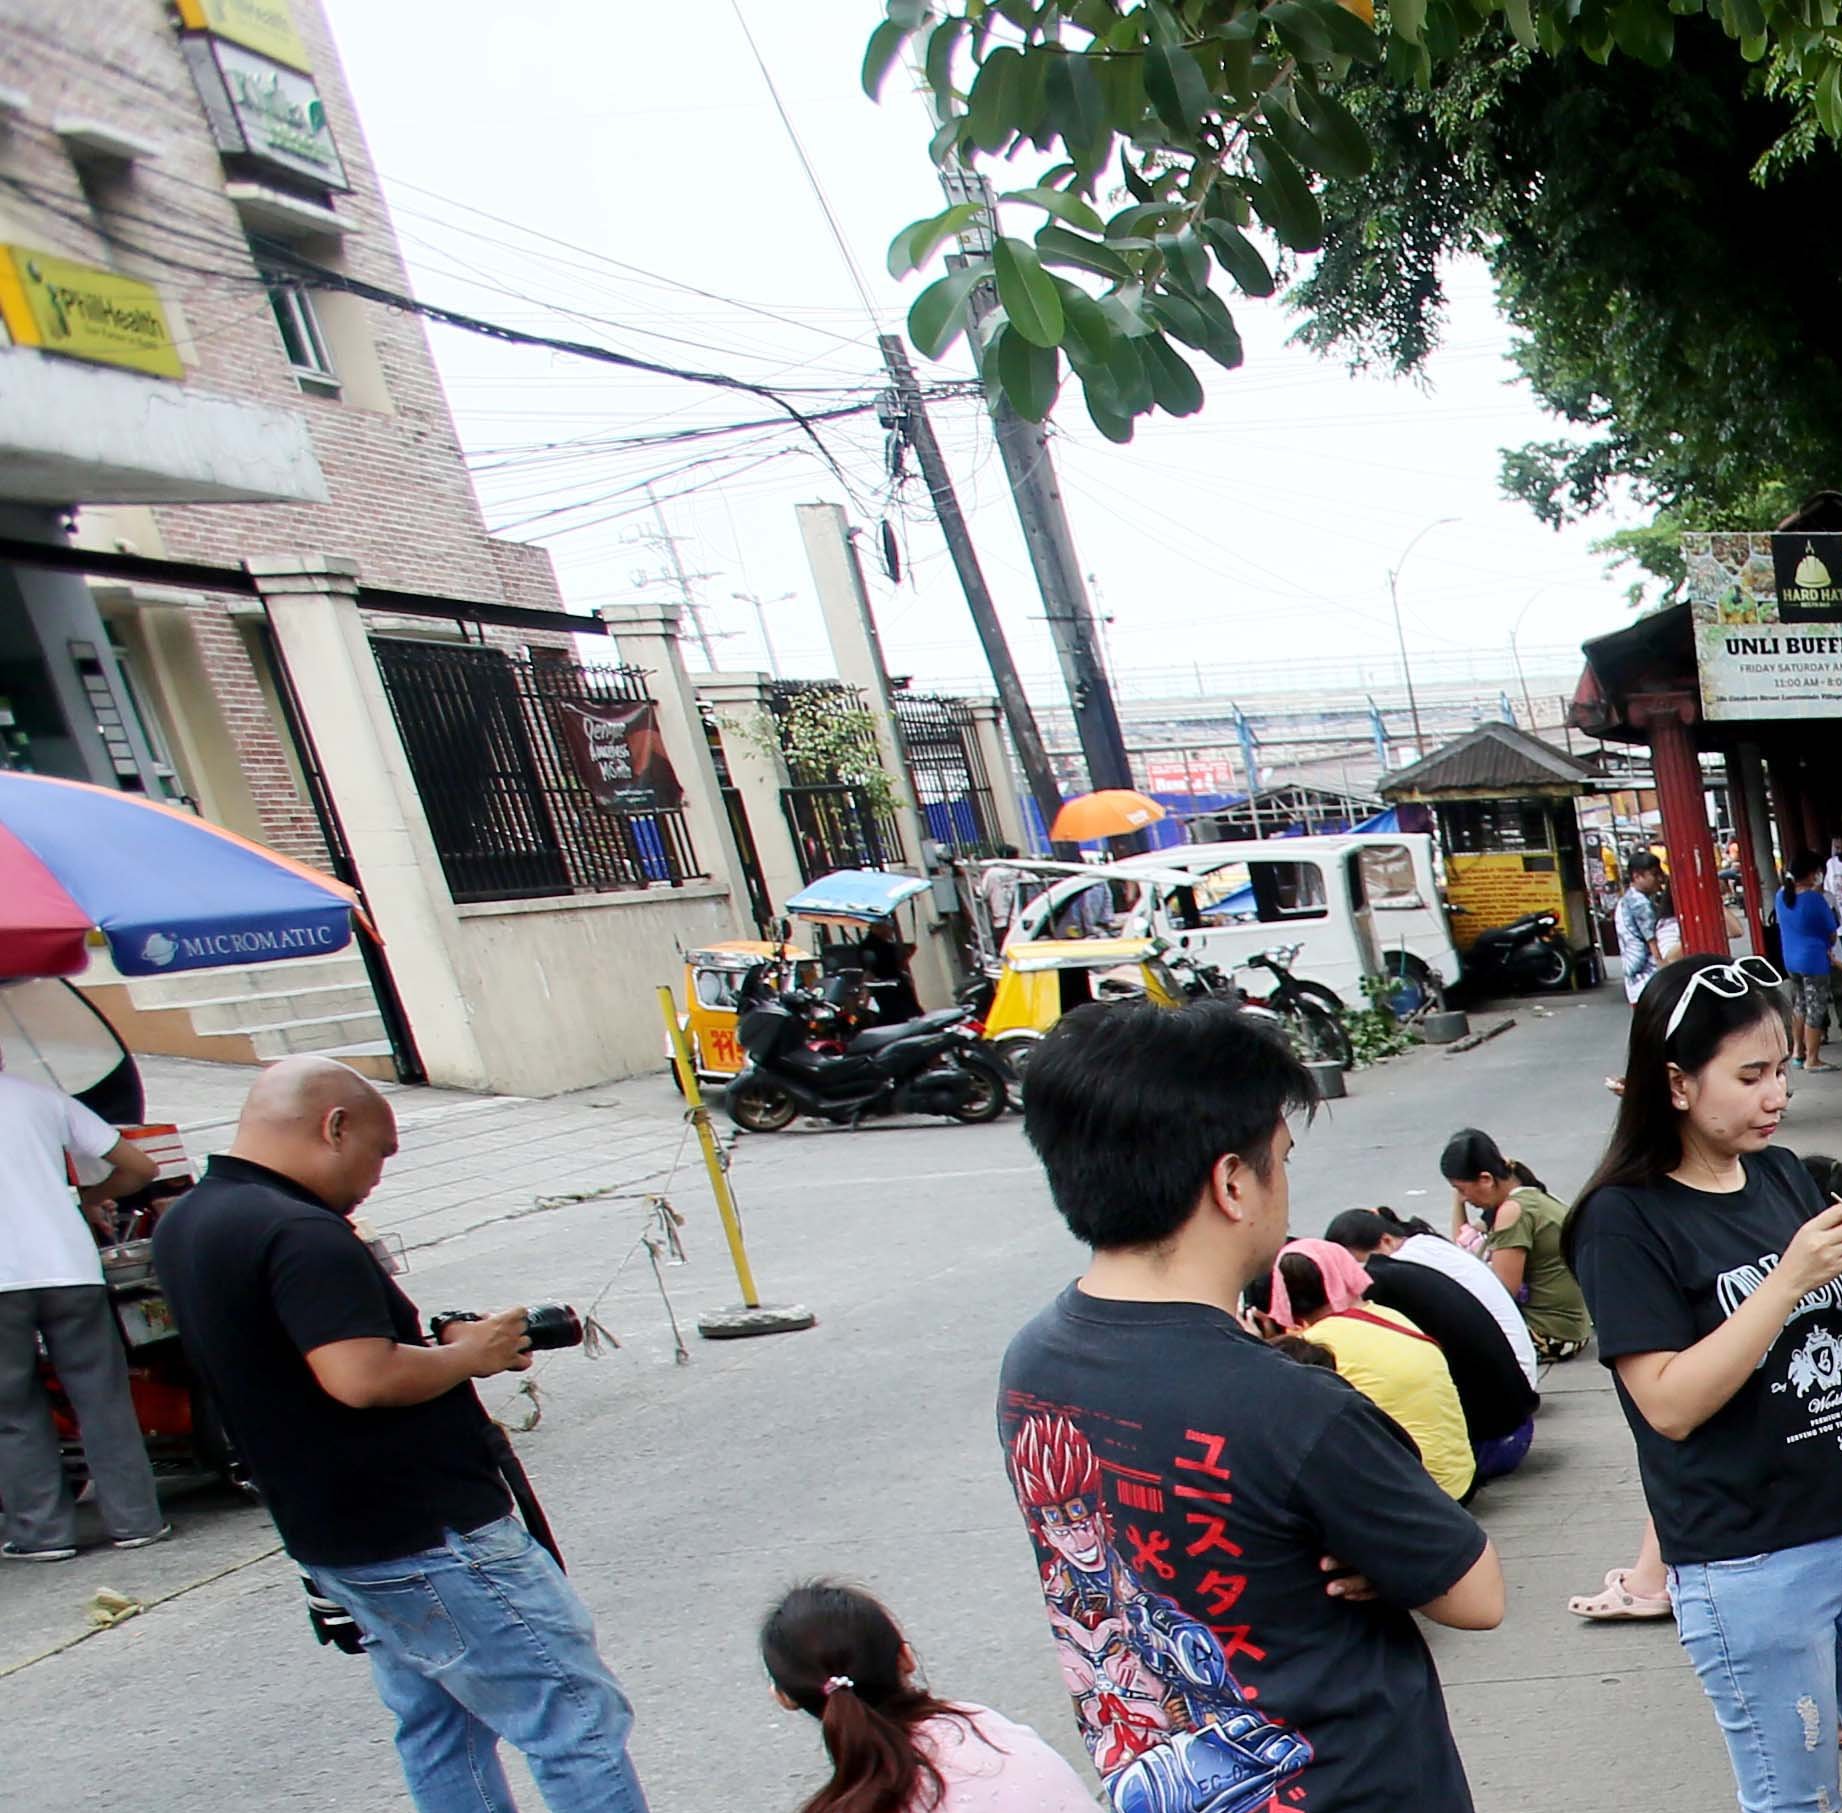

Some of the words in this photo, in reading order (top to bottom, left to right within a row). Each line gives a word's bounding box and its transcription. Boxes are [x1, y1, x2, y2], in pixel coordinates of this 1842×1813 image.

[1783, 588, 1819, 601] HARD
[1726, 638, 1780, 655] UNLI
[1740, 663, 1775, 673] FRIDAY
[1777, 663, 1830, 672] SATURDAY
[1774, 678, 1801, 688] 11:00
[1803, 678, 1819, 687] AM
[182, 926, 333, 957] MICROMATIC
